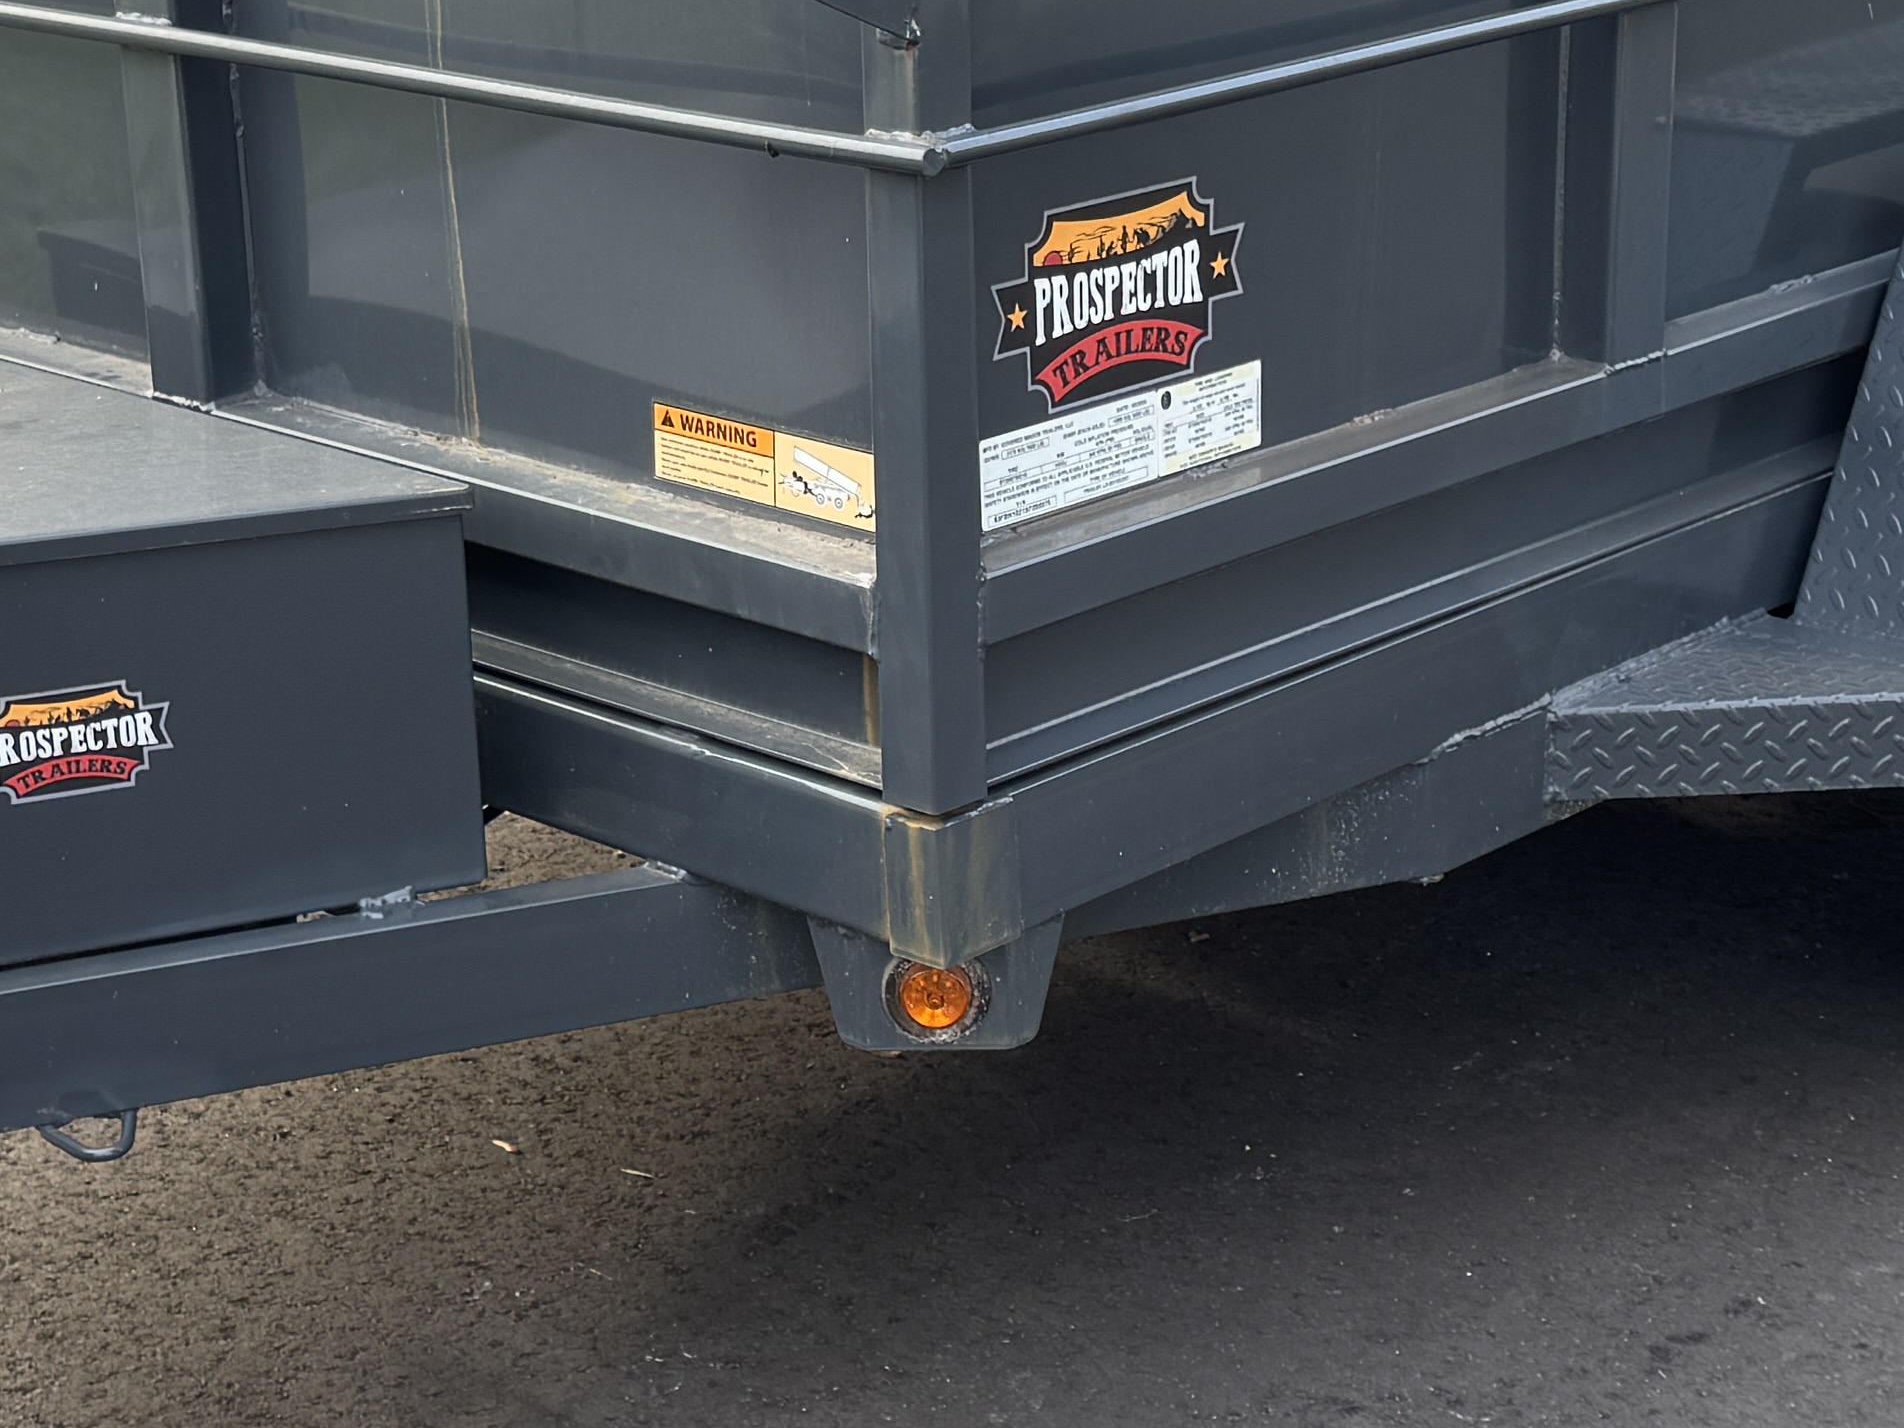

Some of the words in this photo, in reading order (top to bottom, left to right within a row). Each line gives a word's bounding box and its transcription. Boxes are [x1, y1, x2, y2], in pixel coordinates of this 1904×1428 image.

[1033, 238, 1204, 347] PROSPECTOR
[1052, 326, 1190, 390] TRAILERS
[679, 413, 758, 448] WARNING
[17, 757, 128, 792] TRAILERS
